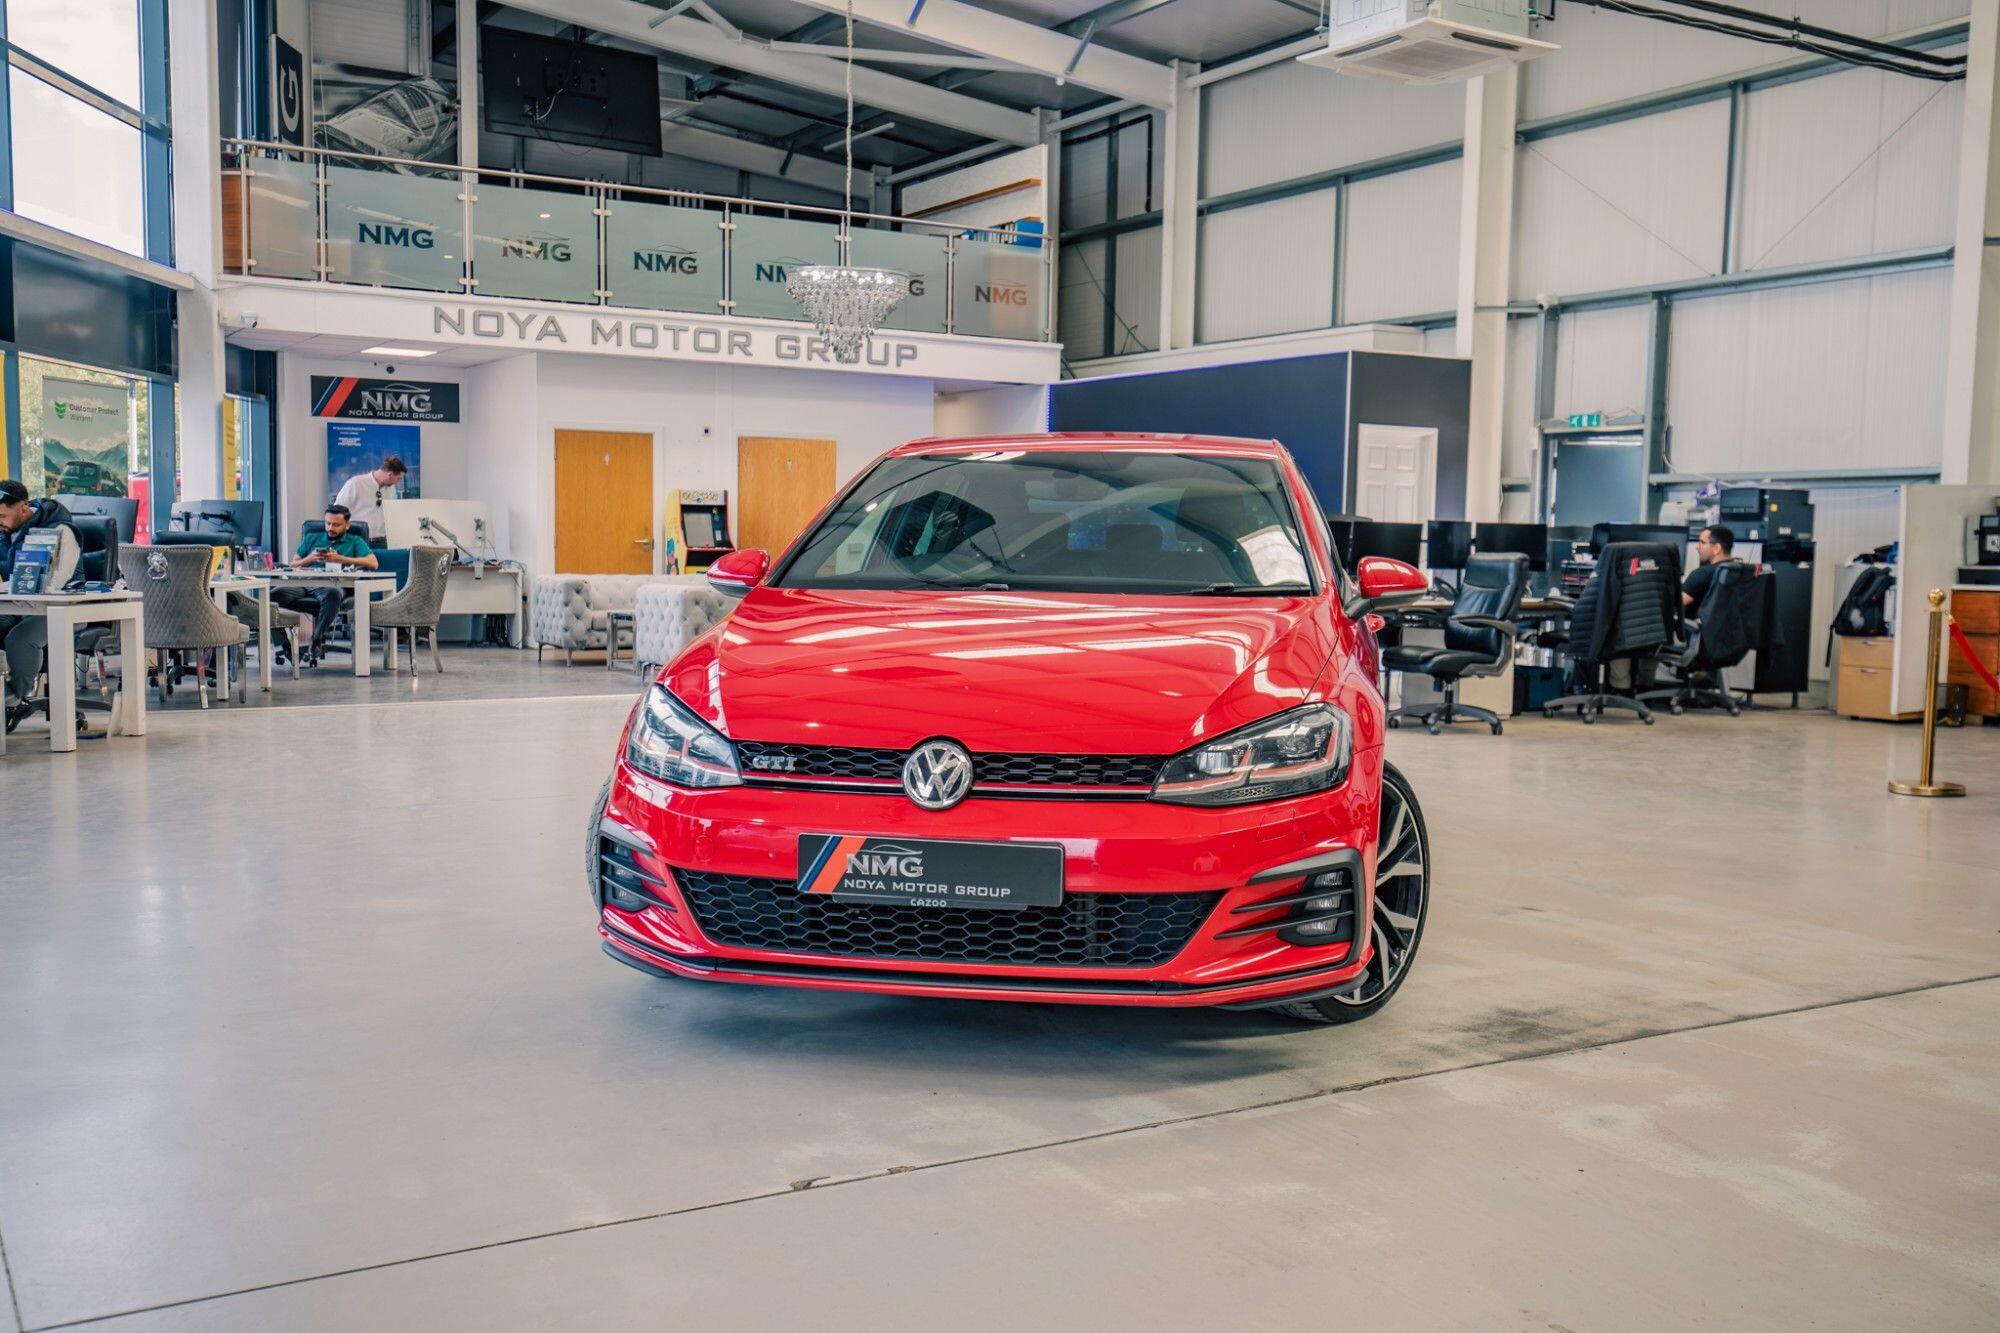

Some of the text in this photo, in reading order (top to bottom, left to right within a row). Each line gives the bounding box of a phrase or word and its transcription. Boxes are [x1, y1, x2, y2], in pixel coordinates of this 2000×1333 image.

[358, 222, 434, 249] NMG
[502, 238, 572, 262] NMG
[633, 251, 698, 275] NMG
[756, 263, 787, 283] NM
[975, 285, 1027, 306] NMG
[434, 306, 567, 343] NOYA
[591, 318, 753, 357] MOTOR
[69, 403, 119, 416] Customer Protect
[361, 391, 432, 413] NMG
[348, 409, 374, 417] NOYA
[752, 755, 798, 771] GTI
[846, 853, 924, 878] NMG
[843, 878, 1011, 899] NOYA MOTOR GROUP
[910, 897, 947, 908] CAZOO
